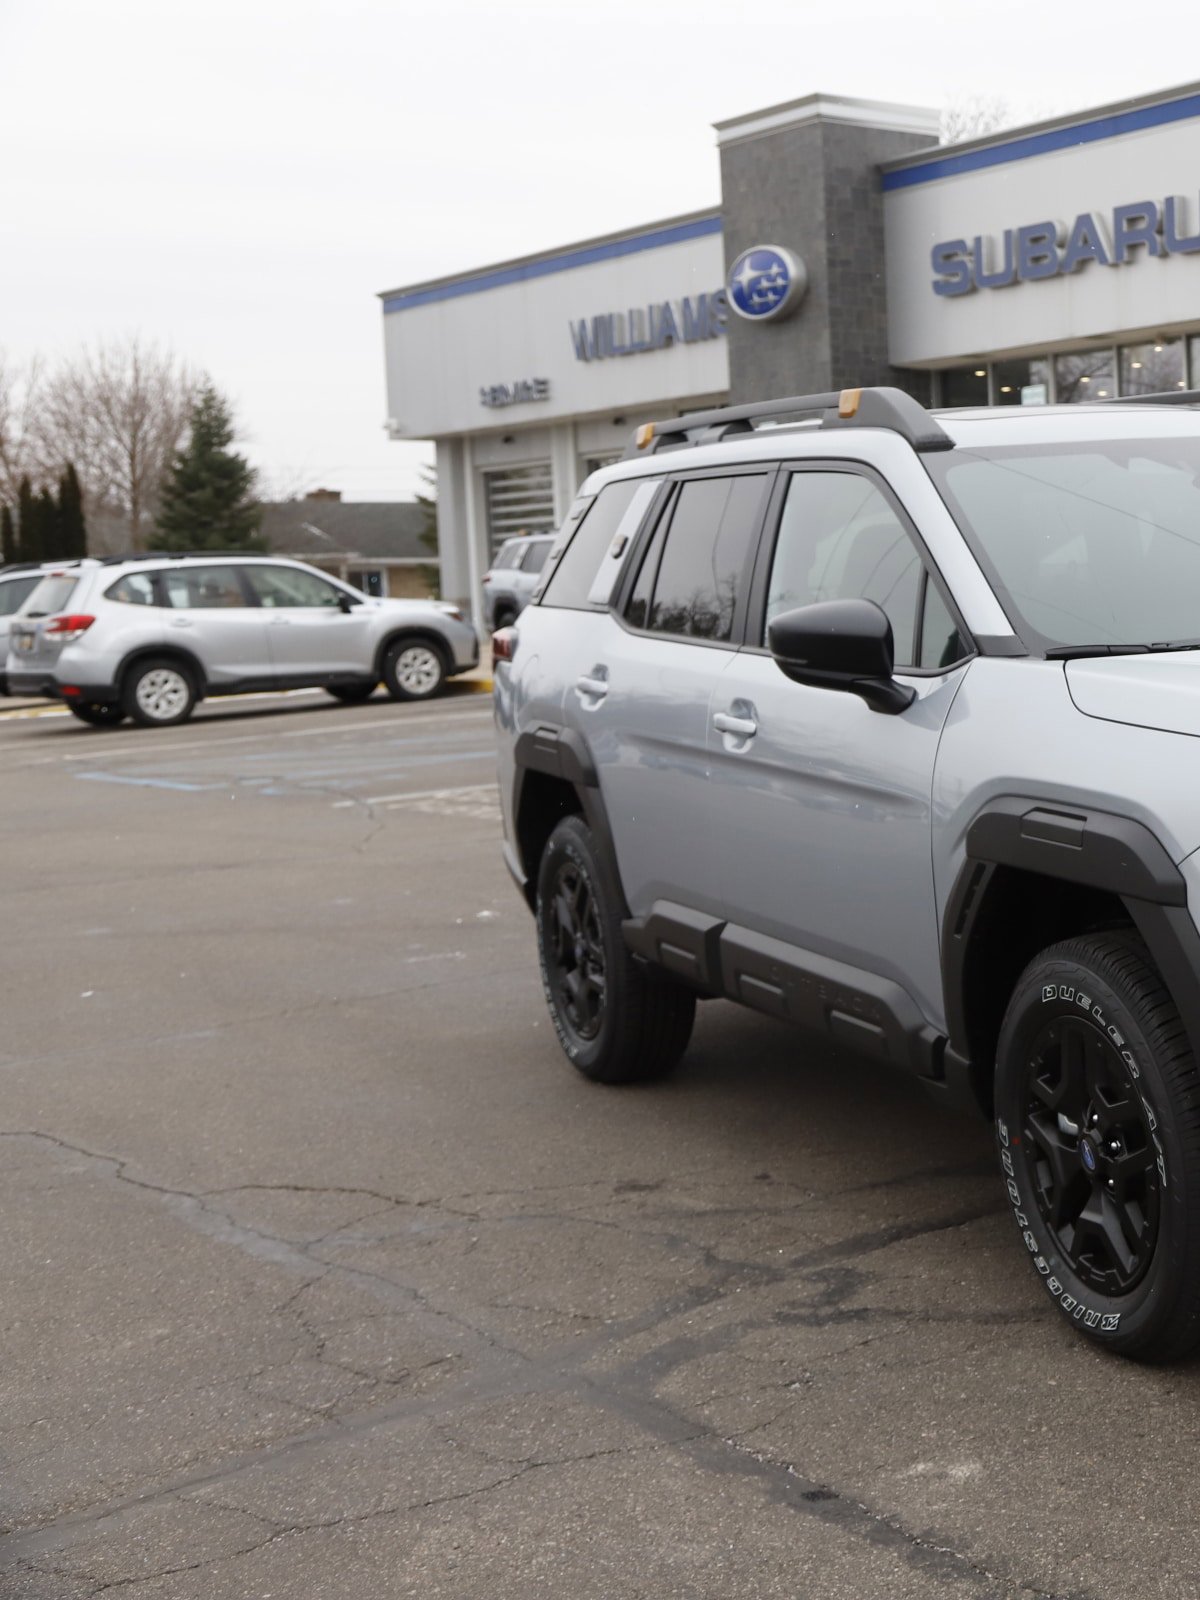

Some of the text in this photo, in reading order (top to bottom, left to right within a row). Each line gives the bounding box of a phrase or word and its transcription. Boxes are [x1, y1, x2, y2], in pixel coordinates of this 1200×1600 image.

[569, 289, 728, 361] WILLIAMS
[1042, 984, 1140, 1079] DUELER
[997, 1118, 1121, 1331] BRIDGESTONE
